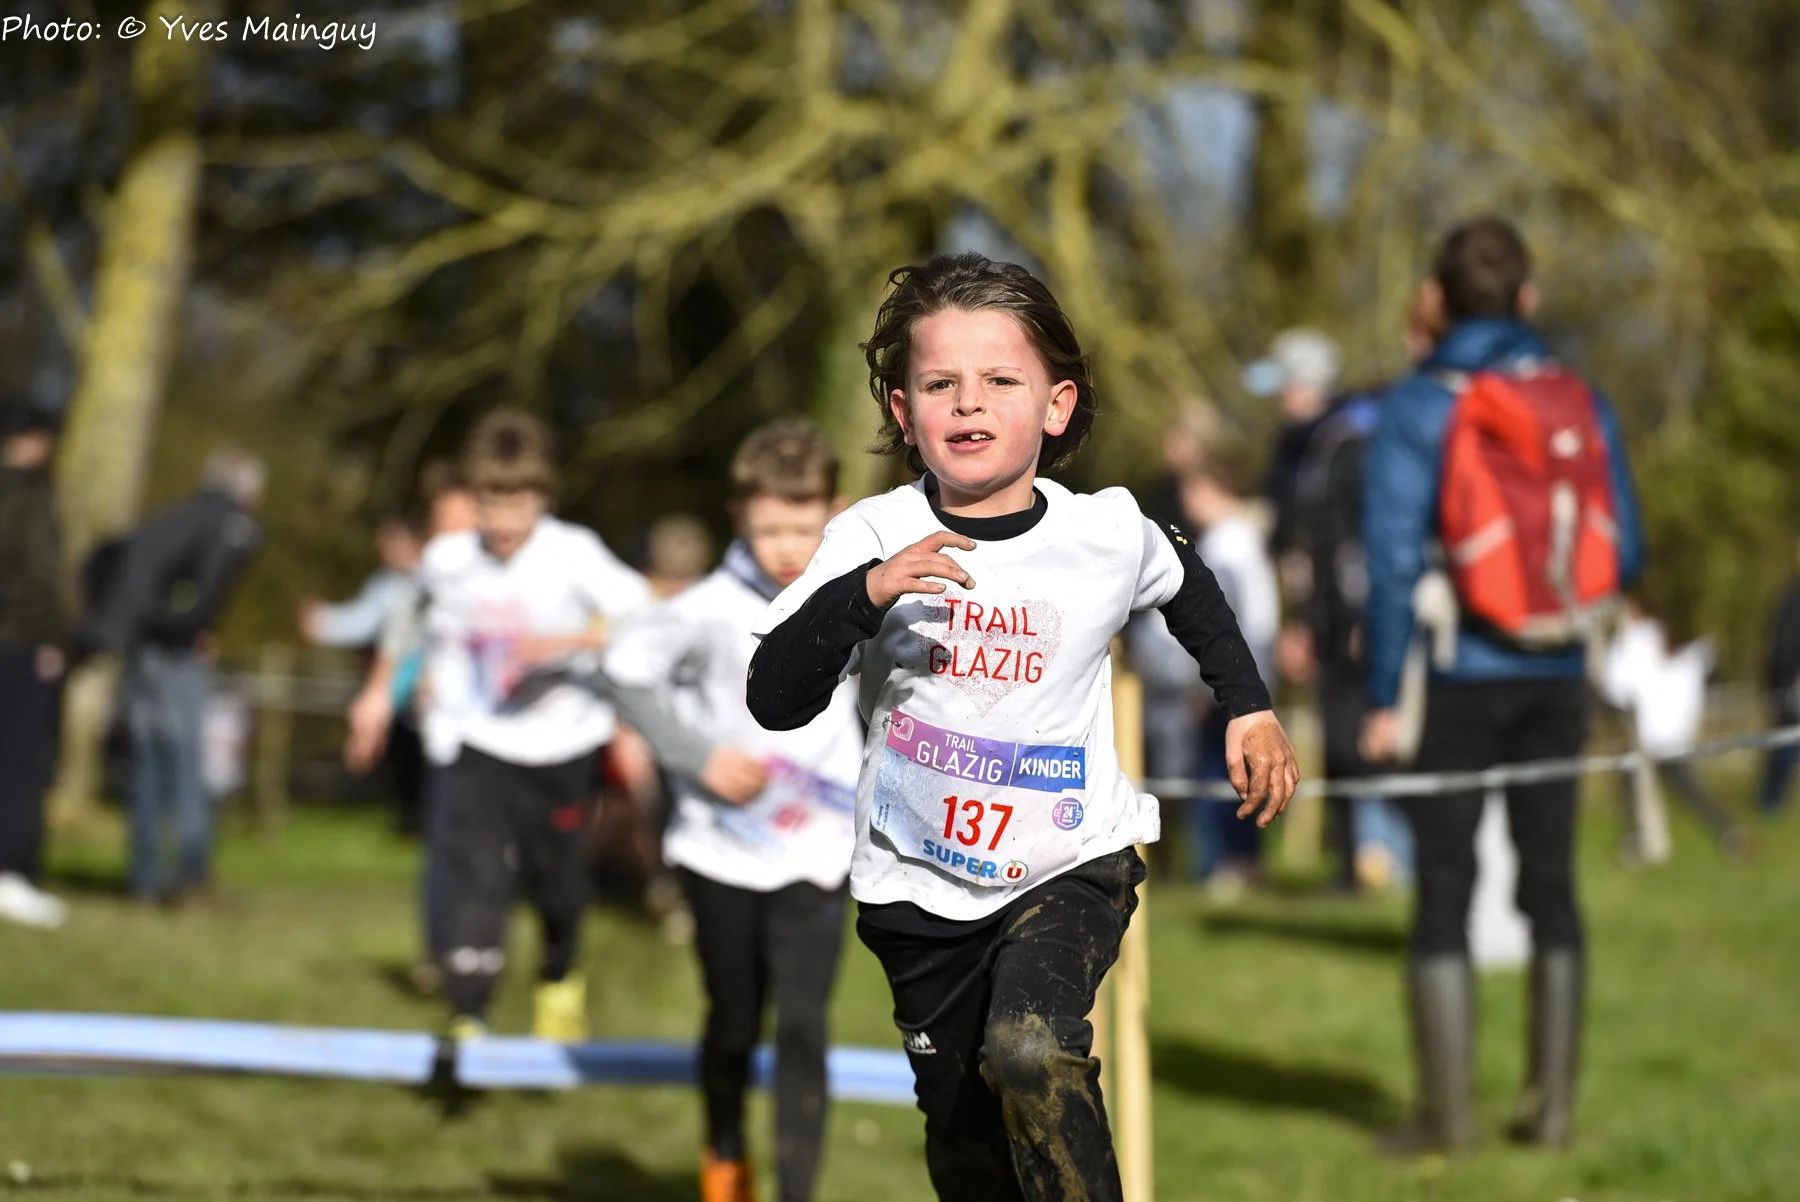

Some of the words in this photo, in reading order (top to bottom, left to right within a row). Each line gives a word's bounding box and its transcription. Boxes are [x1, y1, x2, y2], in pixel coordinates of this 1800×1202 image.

[945, 598, 1038, 636] TRAIL
[928, 644, 1043, 683] GLAZIG
[916, 741, 1002, 783] GLAZIG
[945, 733, 976, 753] TRAIL
[1018, 757, 1082, 780] KINDER
[943, 795, 1014, 851] 137
[923, 839, 997, 880] SUPER
